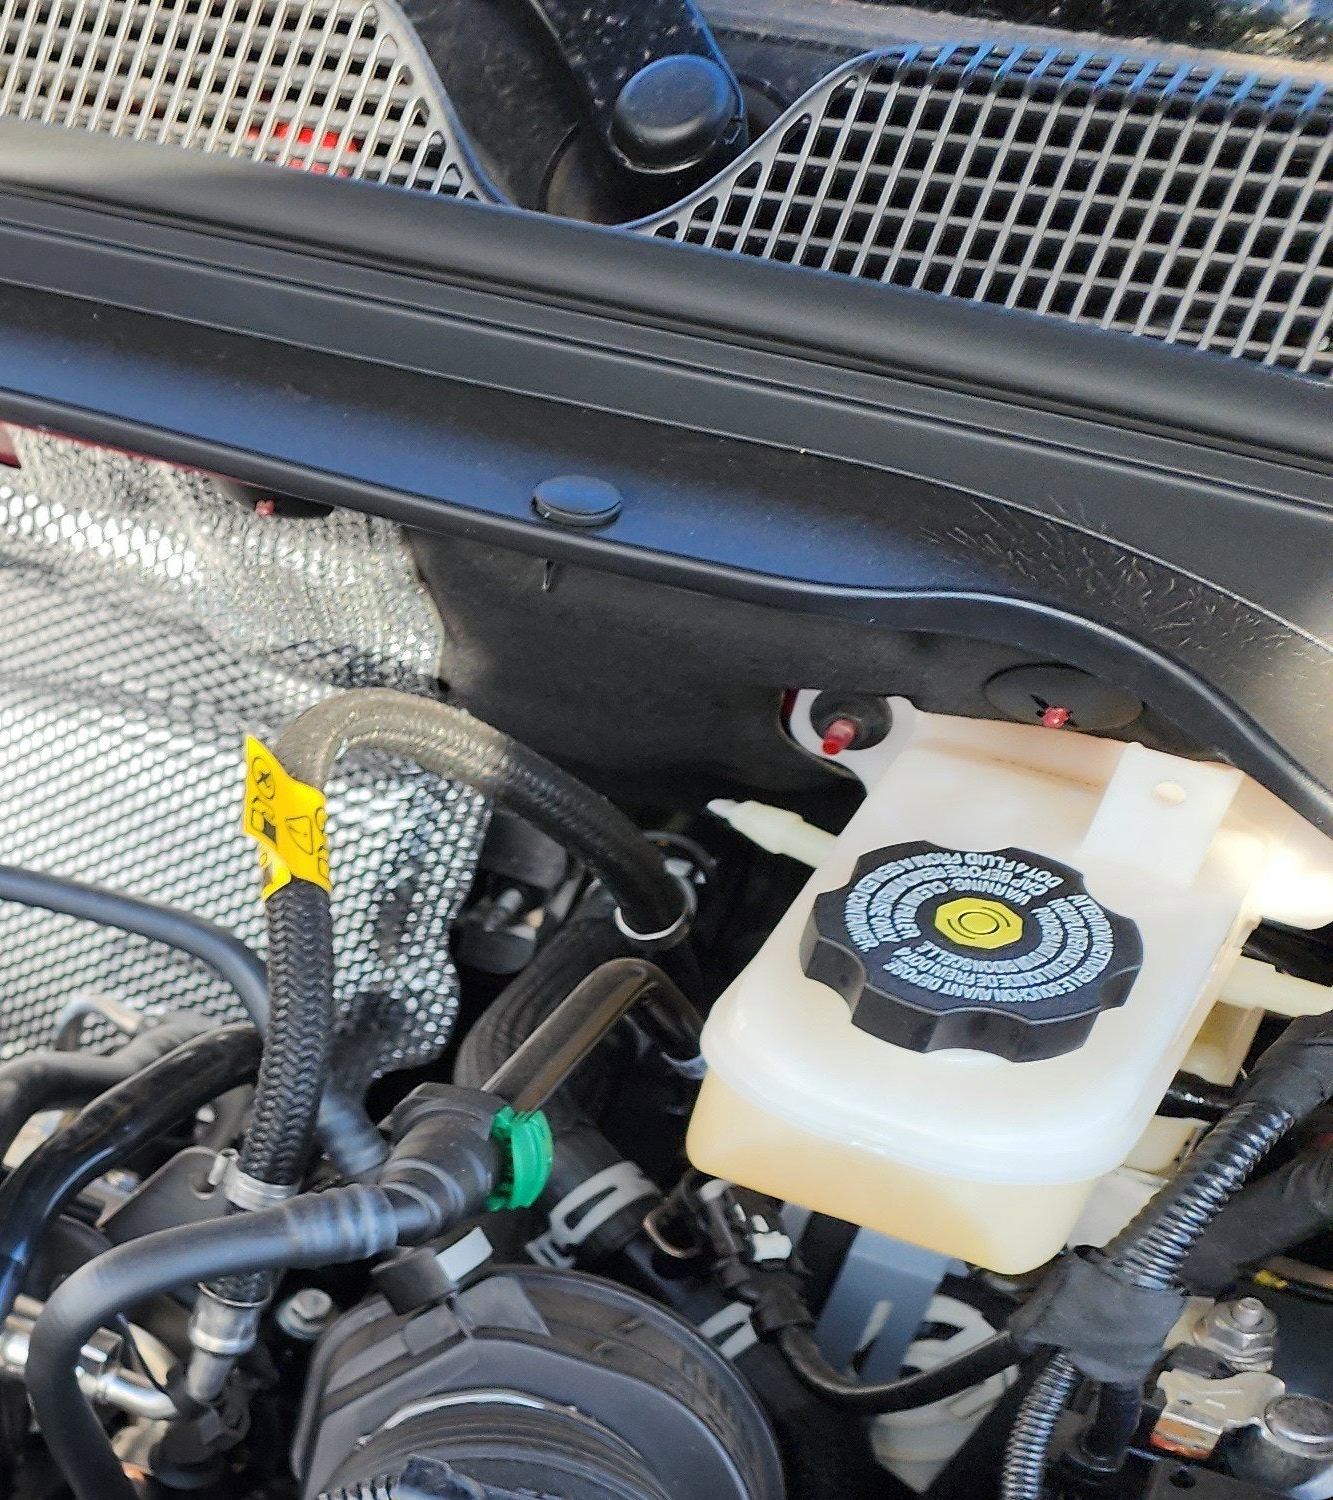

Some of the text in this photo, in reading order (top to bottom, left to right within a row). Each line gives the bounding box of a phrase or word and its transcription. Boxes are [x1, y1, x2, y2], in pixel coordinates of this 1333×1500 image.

[963, 852, 1016, 870] FLUID
[944, 865, 1013, 883] BEFORE
[1023, 867, 1064, 888] DOT
[1009, 878, 1049, 897] CAP
[900, 953, 935, 971] DOT
[928, 964, 975, 985] FREIN
